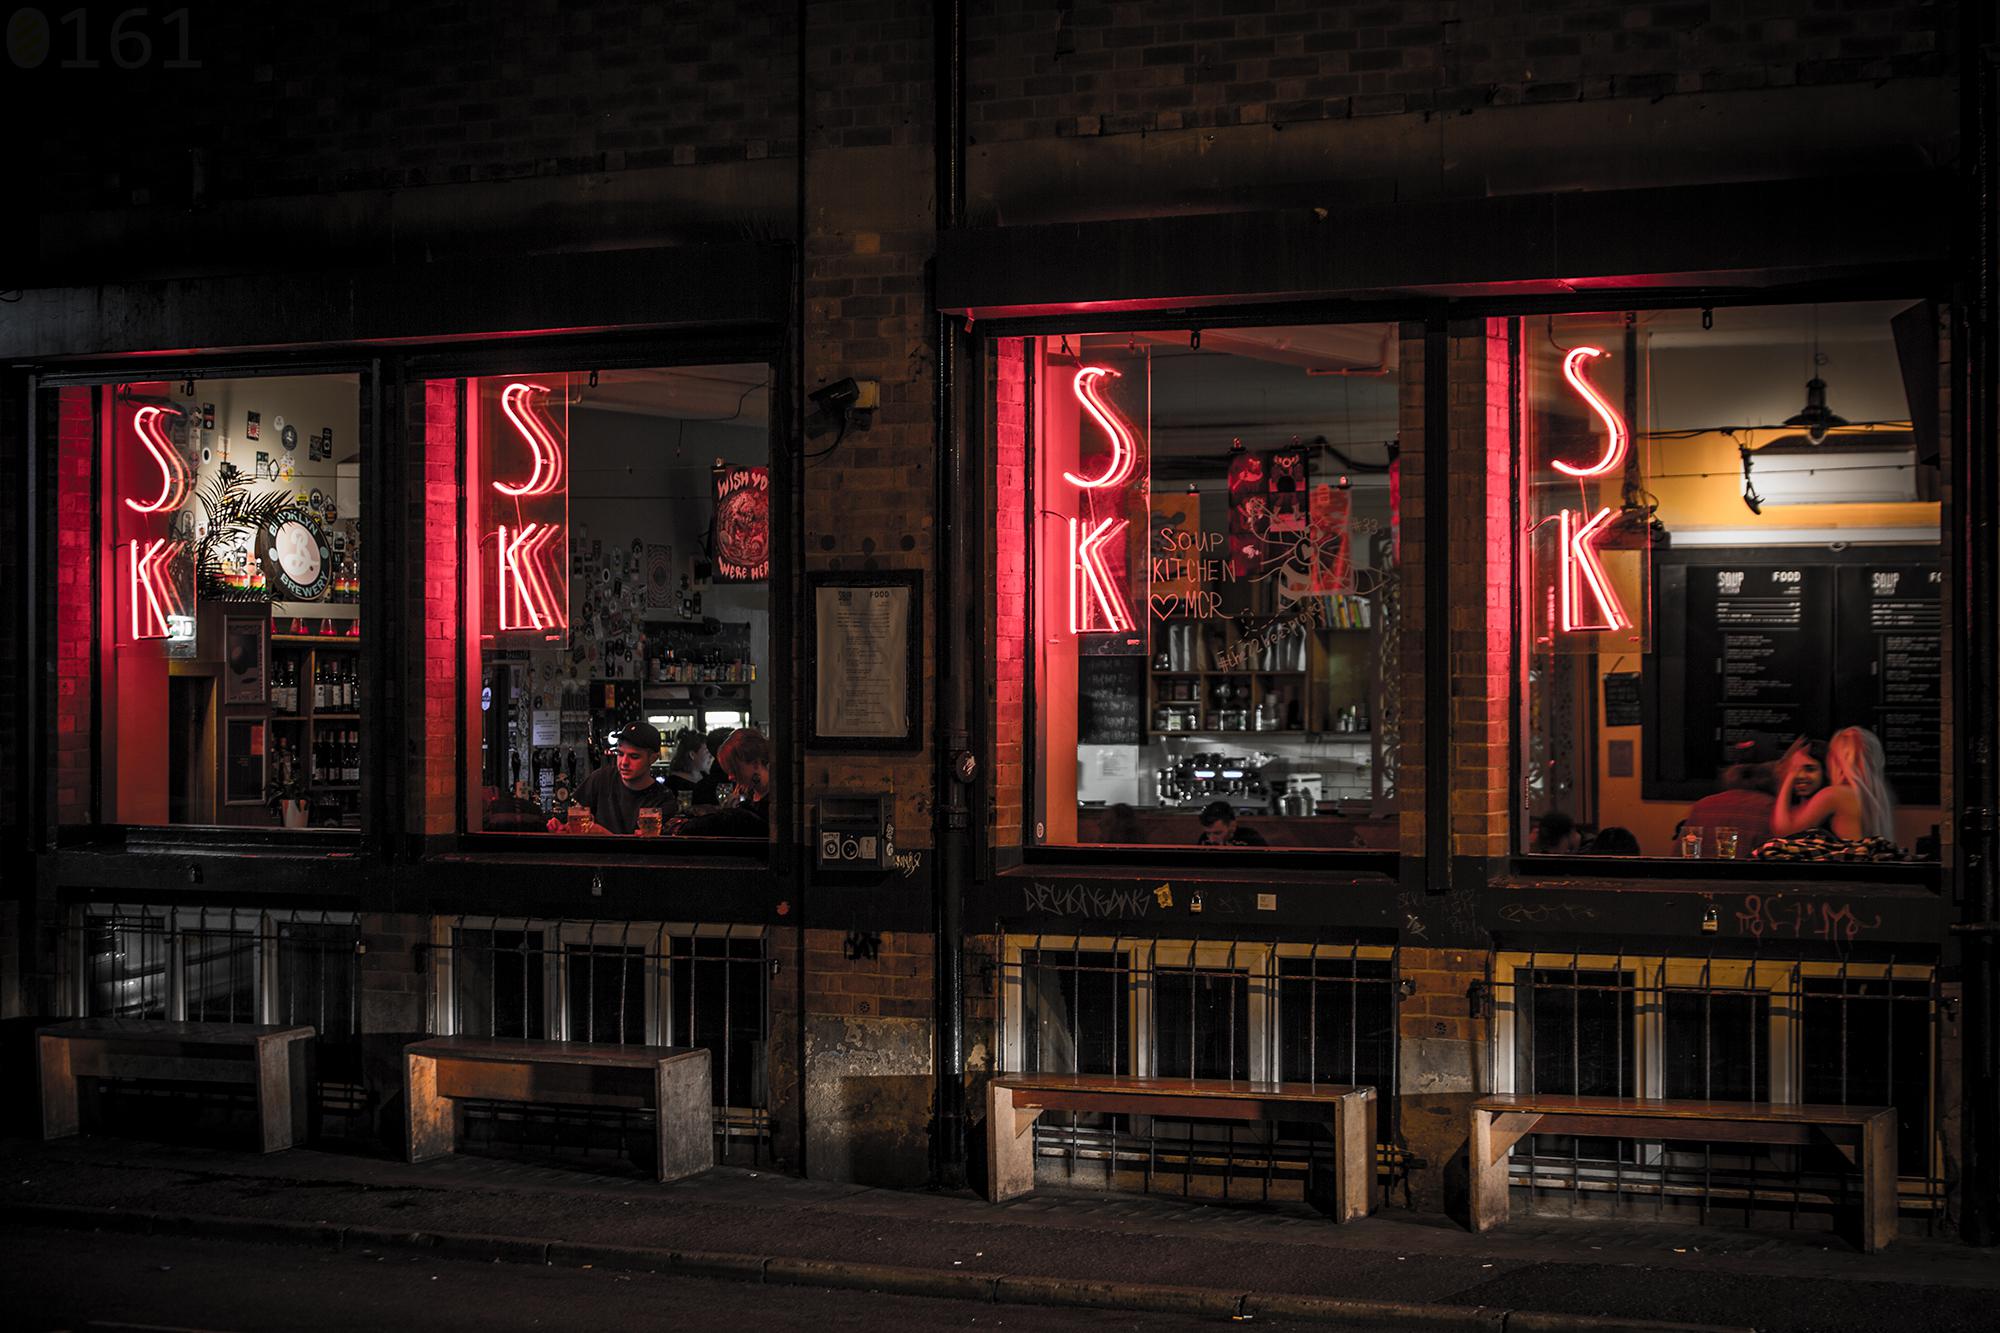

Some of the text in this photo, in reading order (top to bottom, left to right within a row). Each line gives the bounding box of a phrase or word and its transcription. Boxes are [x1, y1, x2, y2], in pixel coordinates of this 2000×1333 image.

[717, 471, 749, 500] WISH
[269, 510, 319, 537] BOKLYN
[1160, 527, 1224, 552] SOUP
[718, 556, 748, 579] WERE
[1152, 557, 1236, 583] KITCHEN
[1717, 571, 1745, 587] SOUP
[1772, 571, 1801, 582] FOOD
[1872, 572, 1900, 588] SOUP
[280, 571, 329, 597] BREWERY
[869, 590, 890, 599] FOOD
[1184, 591, 1235, 619] MCR
